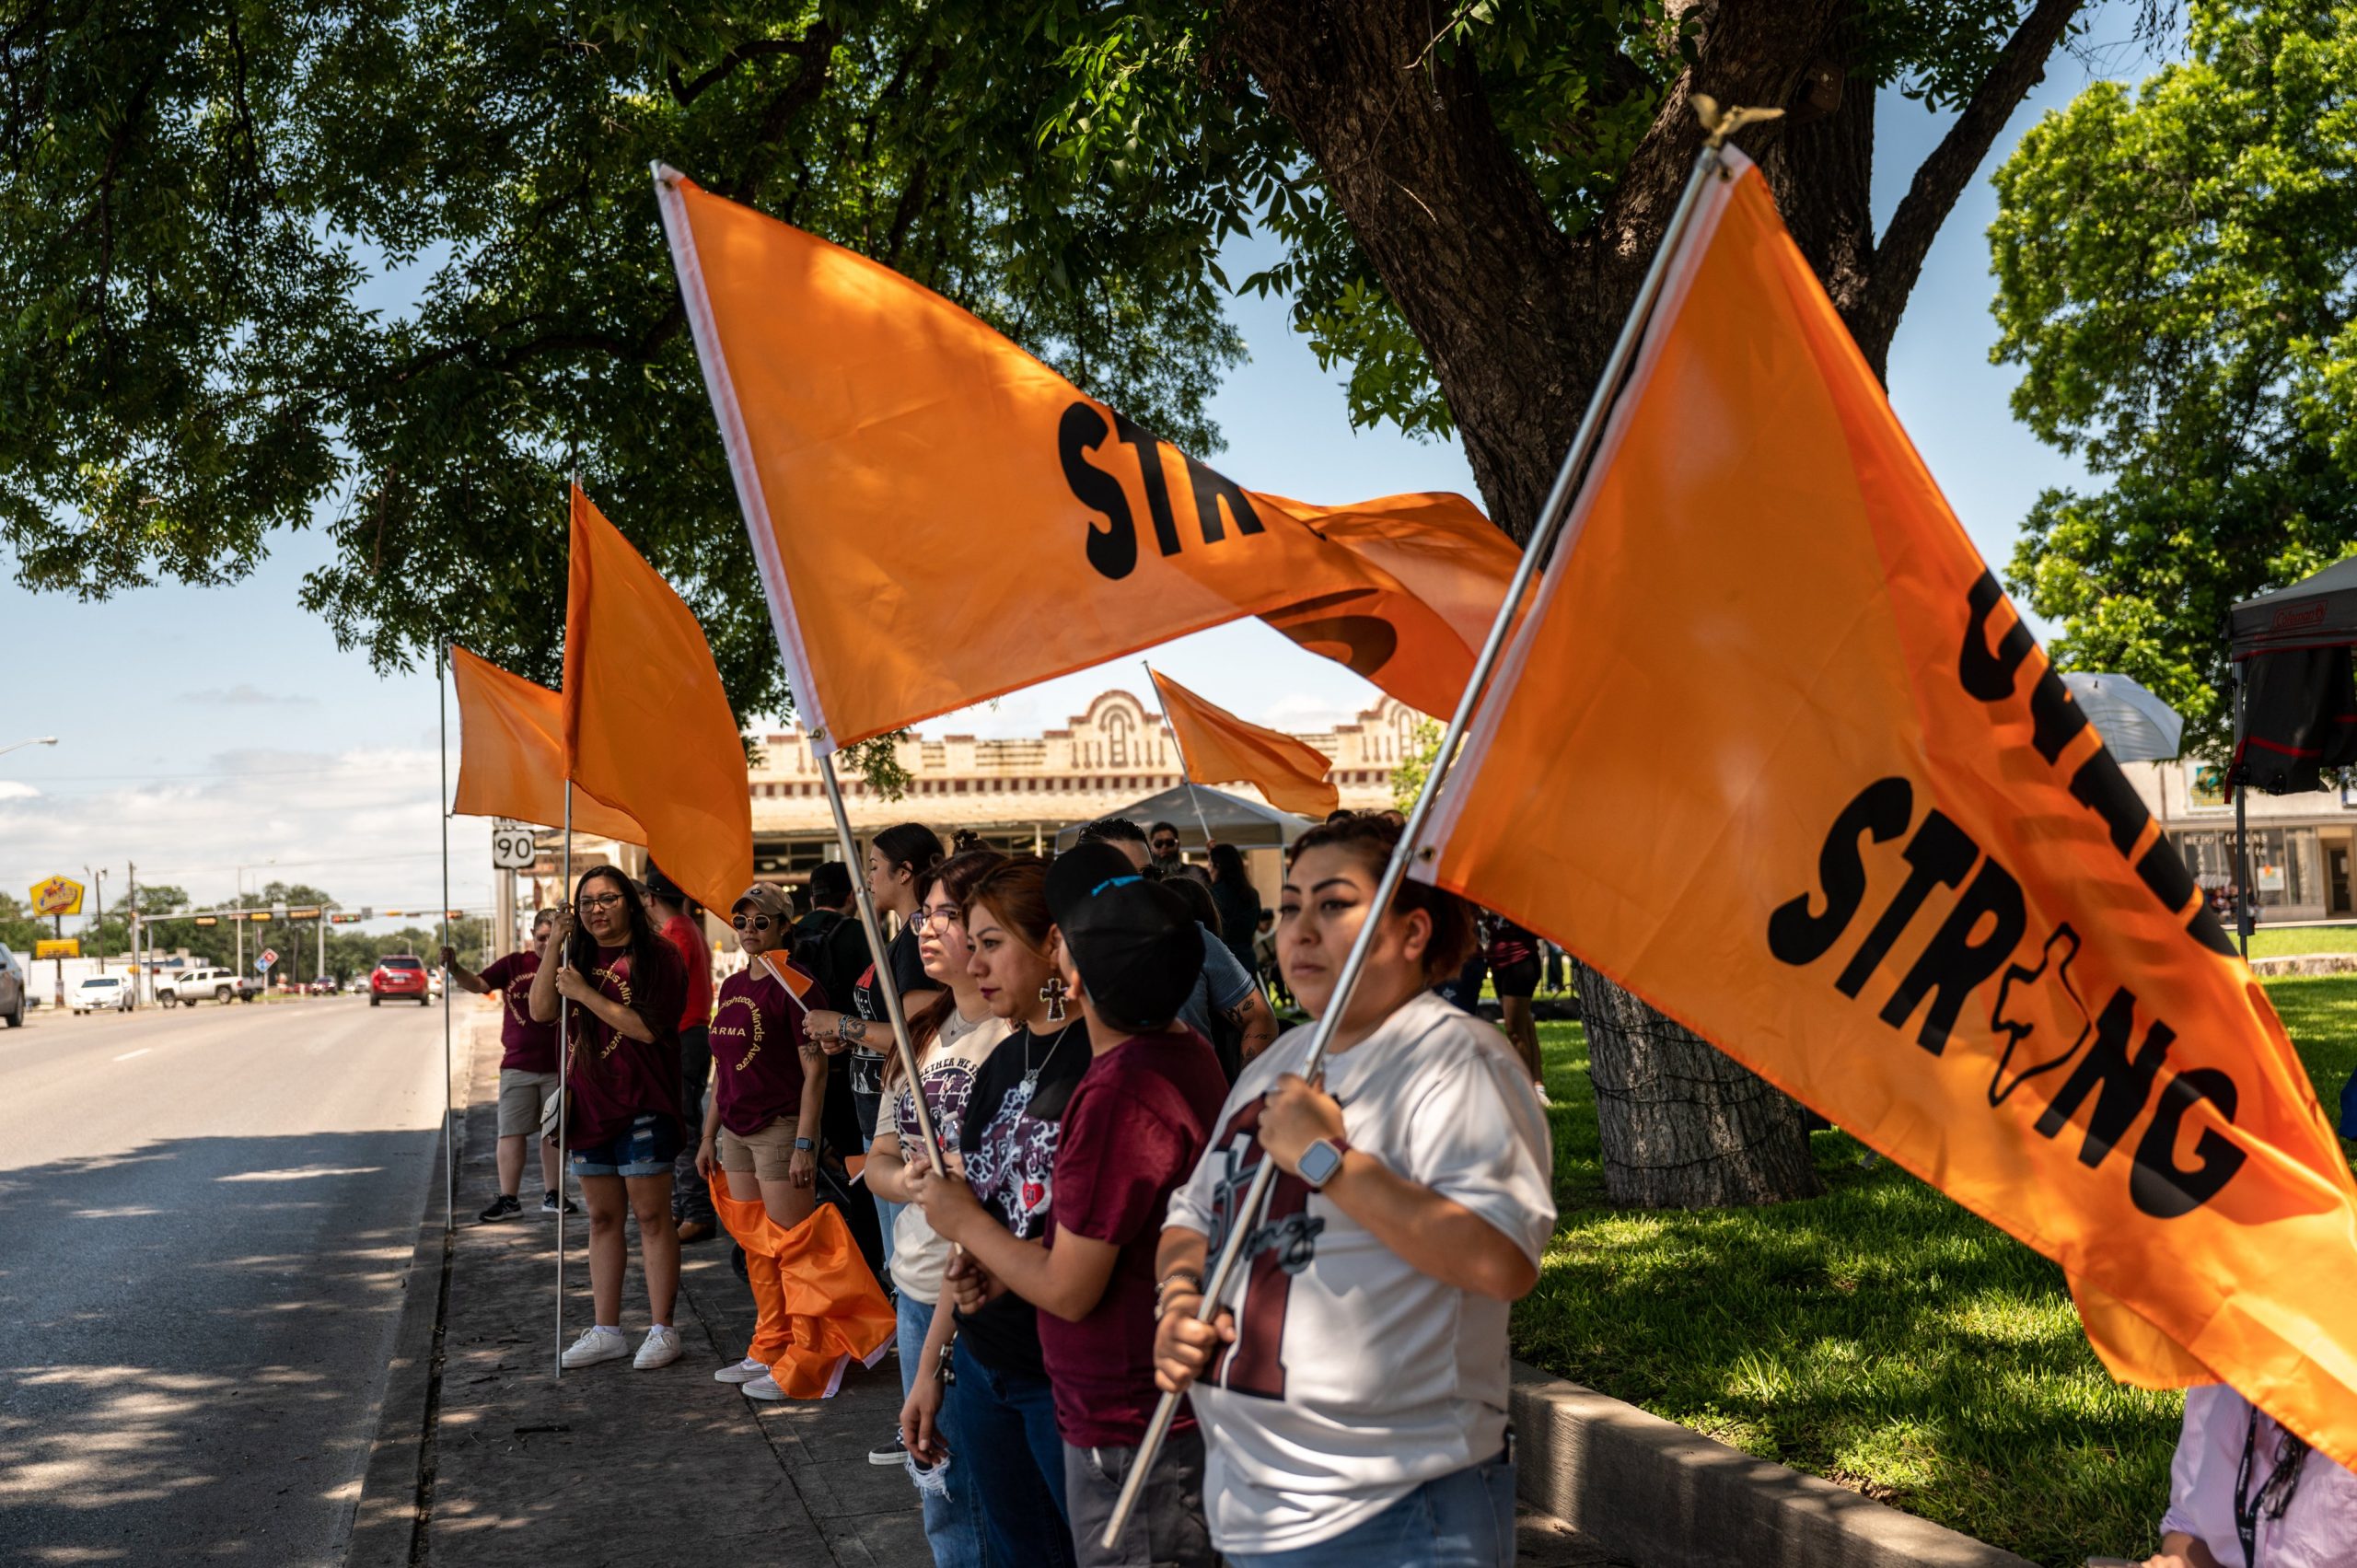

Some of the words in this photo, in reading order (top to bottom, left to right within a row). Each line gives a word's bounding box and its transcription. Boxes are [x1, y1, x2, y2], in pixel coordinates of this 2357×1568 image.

[497, 838, 530, 858] 90
[711, 1027, 746, 1037] ARMA
[751, 1008, 765, 1041] Minds
[600, 1031, 623, 1059] ware
[736, 1043, 761, 1071] Aware
[957, 1057, 971, 1069] WE
